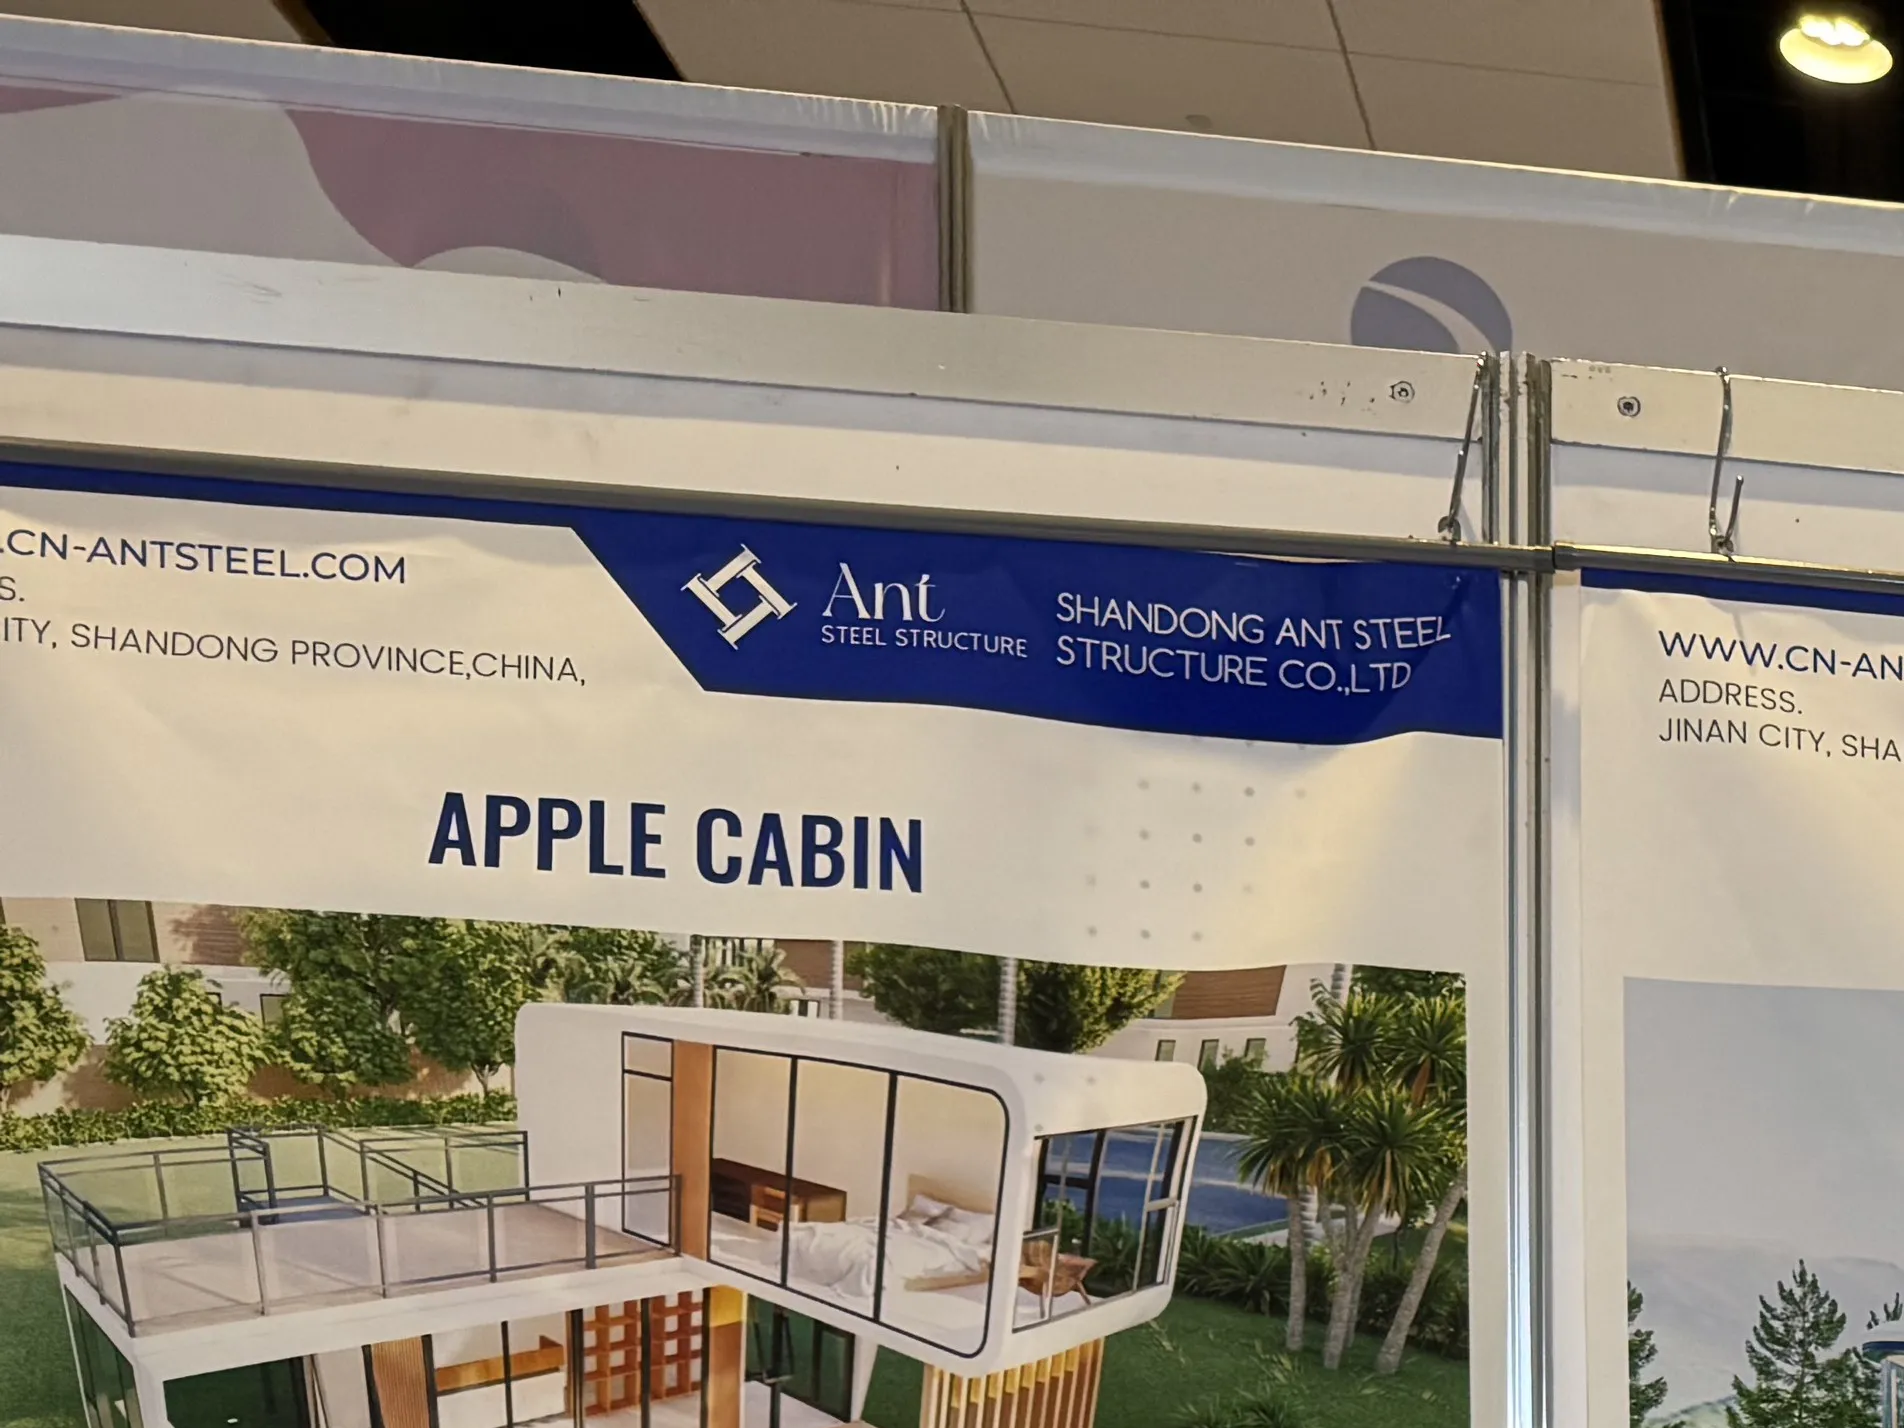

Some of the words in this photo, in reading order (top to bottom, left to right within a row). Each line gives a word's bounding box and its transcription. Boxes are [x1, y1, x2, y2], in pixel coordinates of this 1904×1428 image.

[822, 562, 945, 622] Ant
[1056, 591, 1265, 645] SHANDONG
[1275, 618, 1342, 651] ANT
[1353, 616, 1452, 651] STEEL
[70, 622, 278, 663] SHANDONG
[291, 639, 587, 687] PROVINCE,CHINA,
[821, 625, 886, 647] STEEL
[895, 627, 1028, 658] STRUCTURE
[1056, 635, 1268, 688] STRUCTURE
[1658, 719, 1748, 745] JINAN
[1758, 723, 1832, 758] CITY,
[428, 790, 667, 880] APPLE
[695, 807, 924, 896] CABIN
